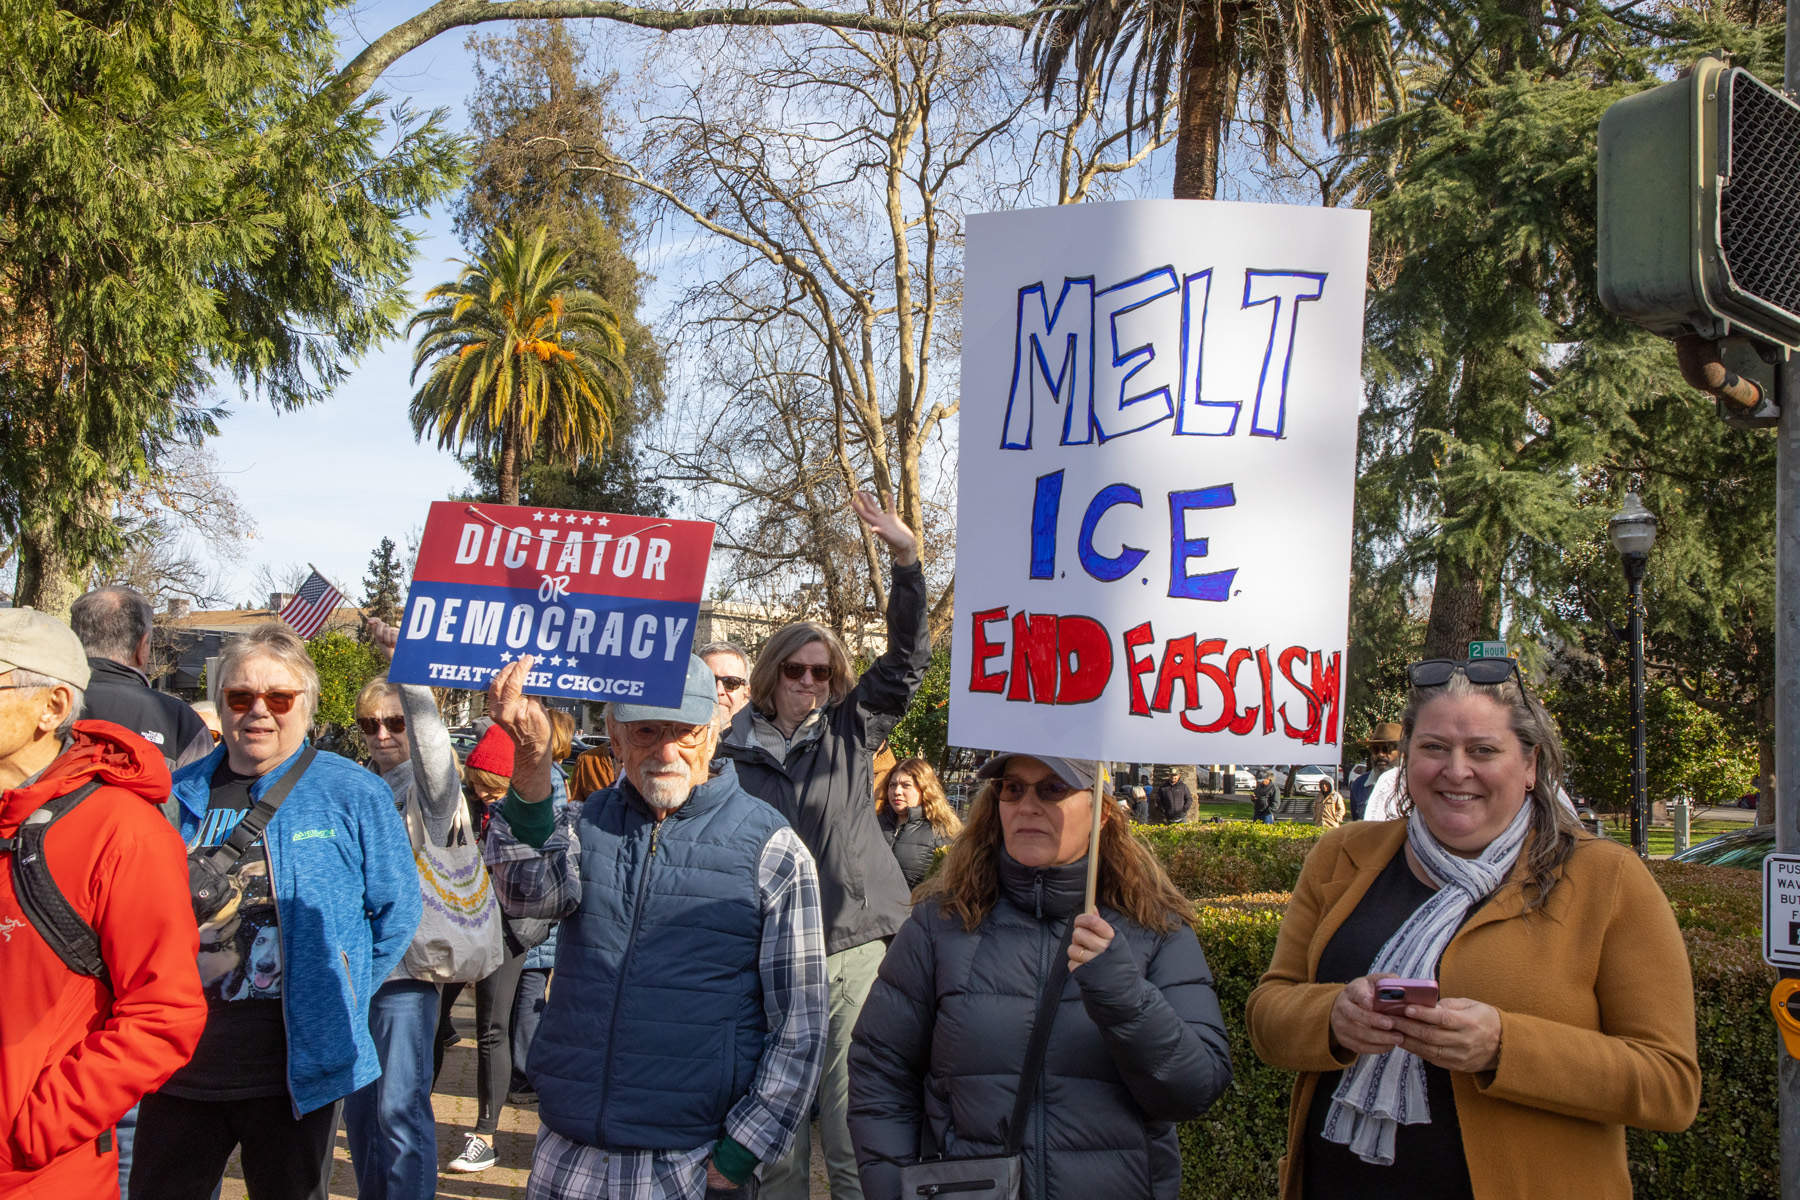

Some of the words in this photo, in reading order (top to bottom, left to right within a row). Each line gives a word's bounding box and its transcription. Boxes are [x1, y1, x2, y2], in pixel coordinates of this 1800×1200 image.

[1000, 264, 1329, 450] MELT
[455, 523, 671, 581] DICTATOR
[1029, 468, 1242, 602] I.C.E.
[538, 574, 570, 603] OR
[406, 596, 689, 662] DEMOCRACY
[1472, 644, 1481, 657] 2
[1484, 646, 1505, 656] HOUR
[523, 671, 553, 688] HE
[557, 673, 645, 696] CHOICE
[969, 605, 1114, 706] END
[1123, 621, 1342, 747] FASCISM
